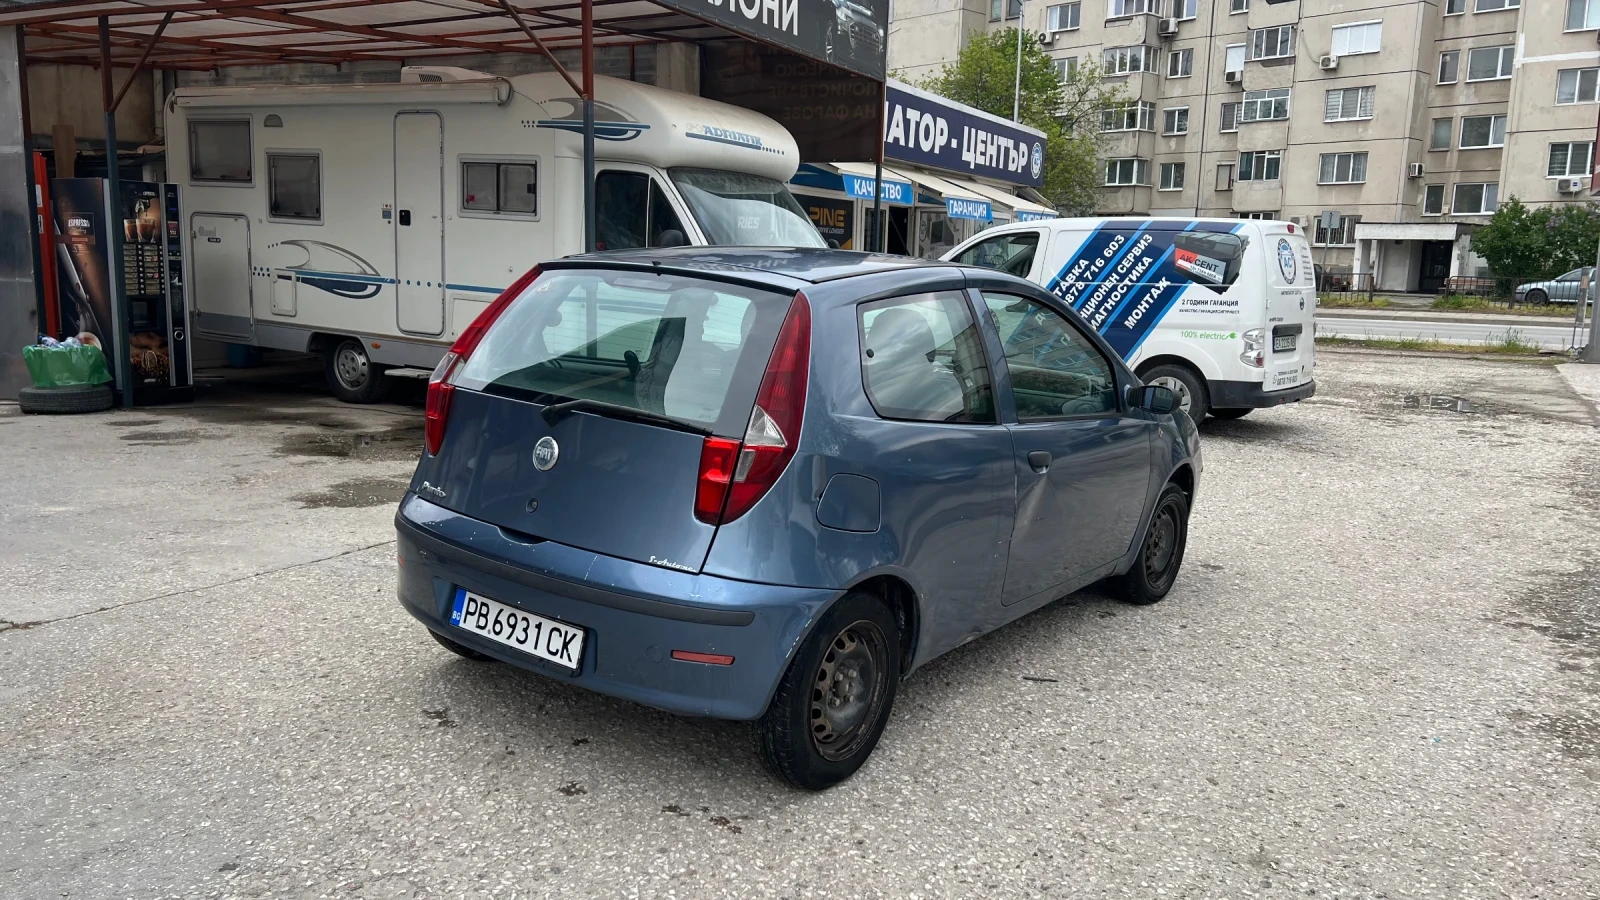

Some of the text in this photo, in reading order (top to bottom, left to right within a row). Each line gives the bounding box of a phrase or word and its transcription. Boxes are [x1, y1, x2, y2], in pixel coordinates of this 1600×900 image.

[703, 125, 762, 146] ADRIATIK
[962, 126, 1028, 173] ЦЕНТЪР
[854, 179, 902, 199] КАЧСТВО
[949, 200, 987, 218] ГАРАНЦИЯ
[1053, 259, 1090, 297] ТАВКА
[1064, 234, 1125, 305] 878 716 603
[1080, 234, 1153, 319] НЦИОНЕН СЕРВИЗ
[1090, 256, 1153, 330] ИАГНОСТИКА
[1124, 276, 1171, 330] МОНТАЖ
[1199, 332, 1226, 340] electric
[536, 446, 552, 460] FIAT
